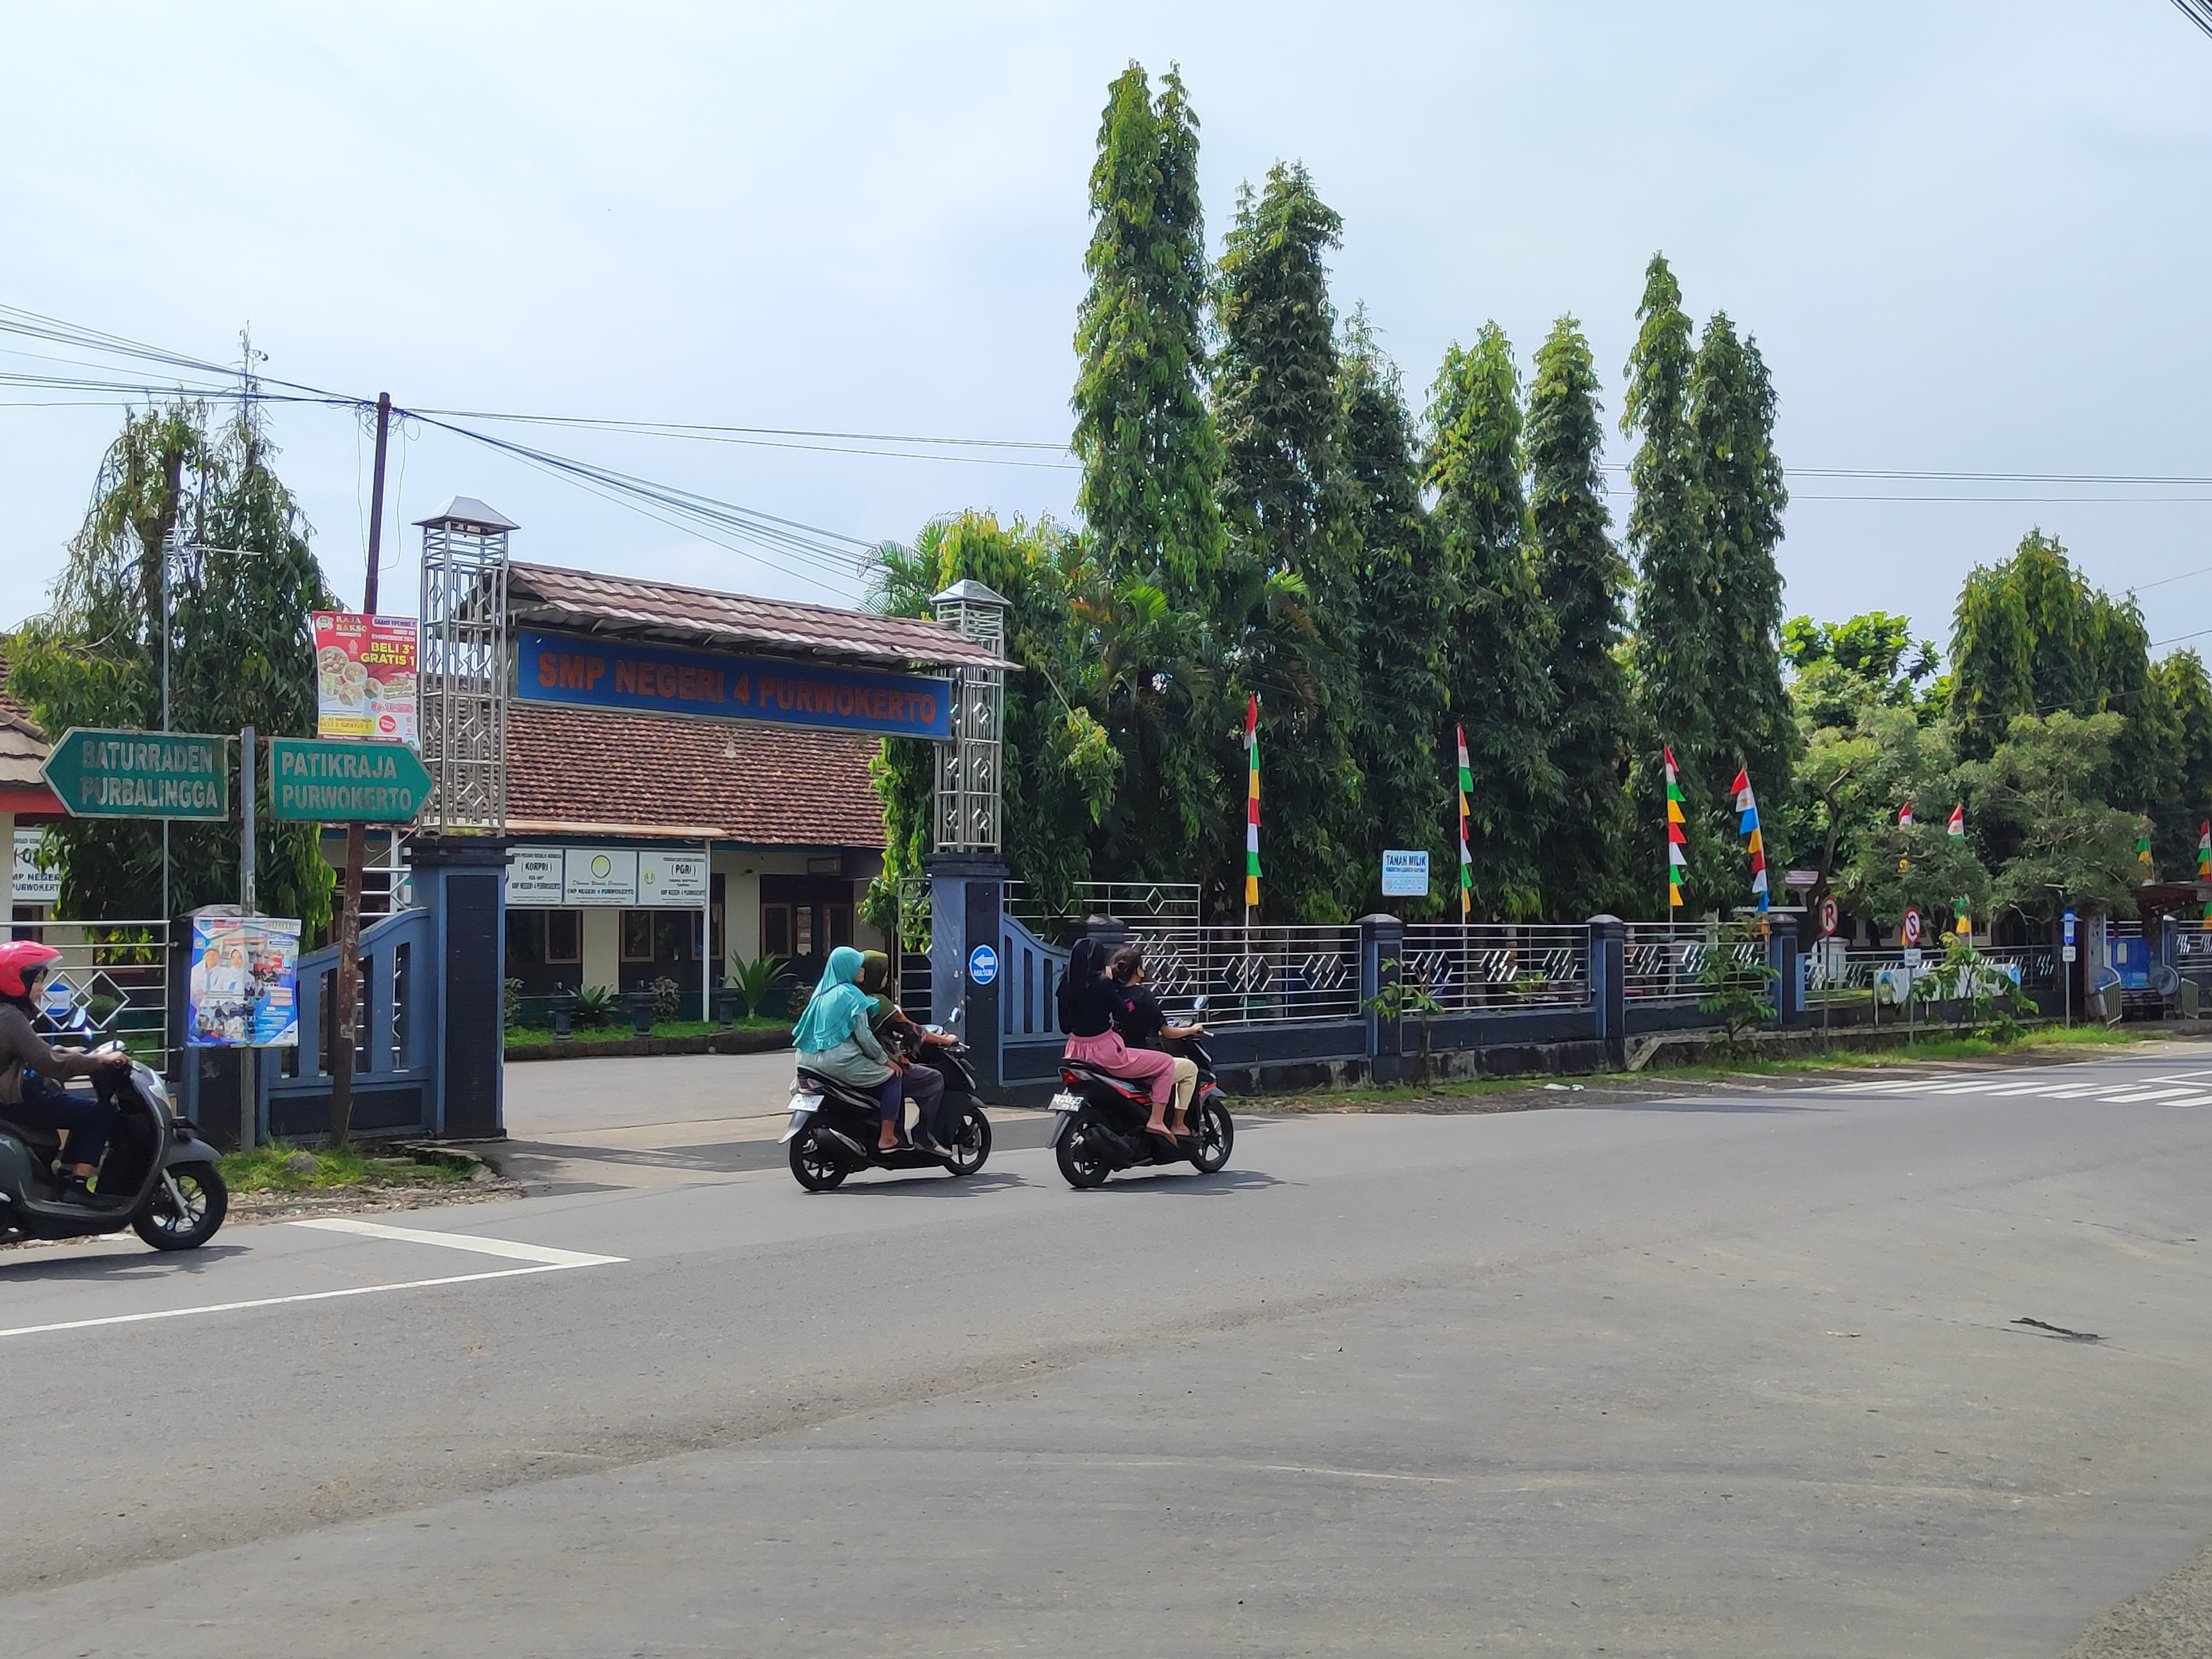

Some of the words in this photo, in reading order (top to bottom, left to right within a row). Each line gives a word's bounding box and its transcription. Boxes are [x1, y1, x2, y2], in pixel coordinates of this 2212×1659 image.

[361, 653, 407, 665] GRATIS
[409, 656, 415, 666] 1
[371, 641, 399, 653] BELI
[538, 652, 606, 690] SMP
[615, 660, 726, 703] NEGERI
[734, 672, 750, 706] 4
[759, 676, 936, 724] PURWOKERTO
[83, 740, 212, 773] BATURRADEN
[282, 752, 397, 779] PATIKRAJA
[81, 777, 218, 808] PURBALINGGA
[283, 785, 412, 811] PURWOKERTO
[1386, 855, 1407, 865] TANAH
[1409, 855, 1426, 866] MILIK
